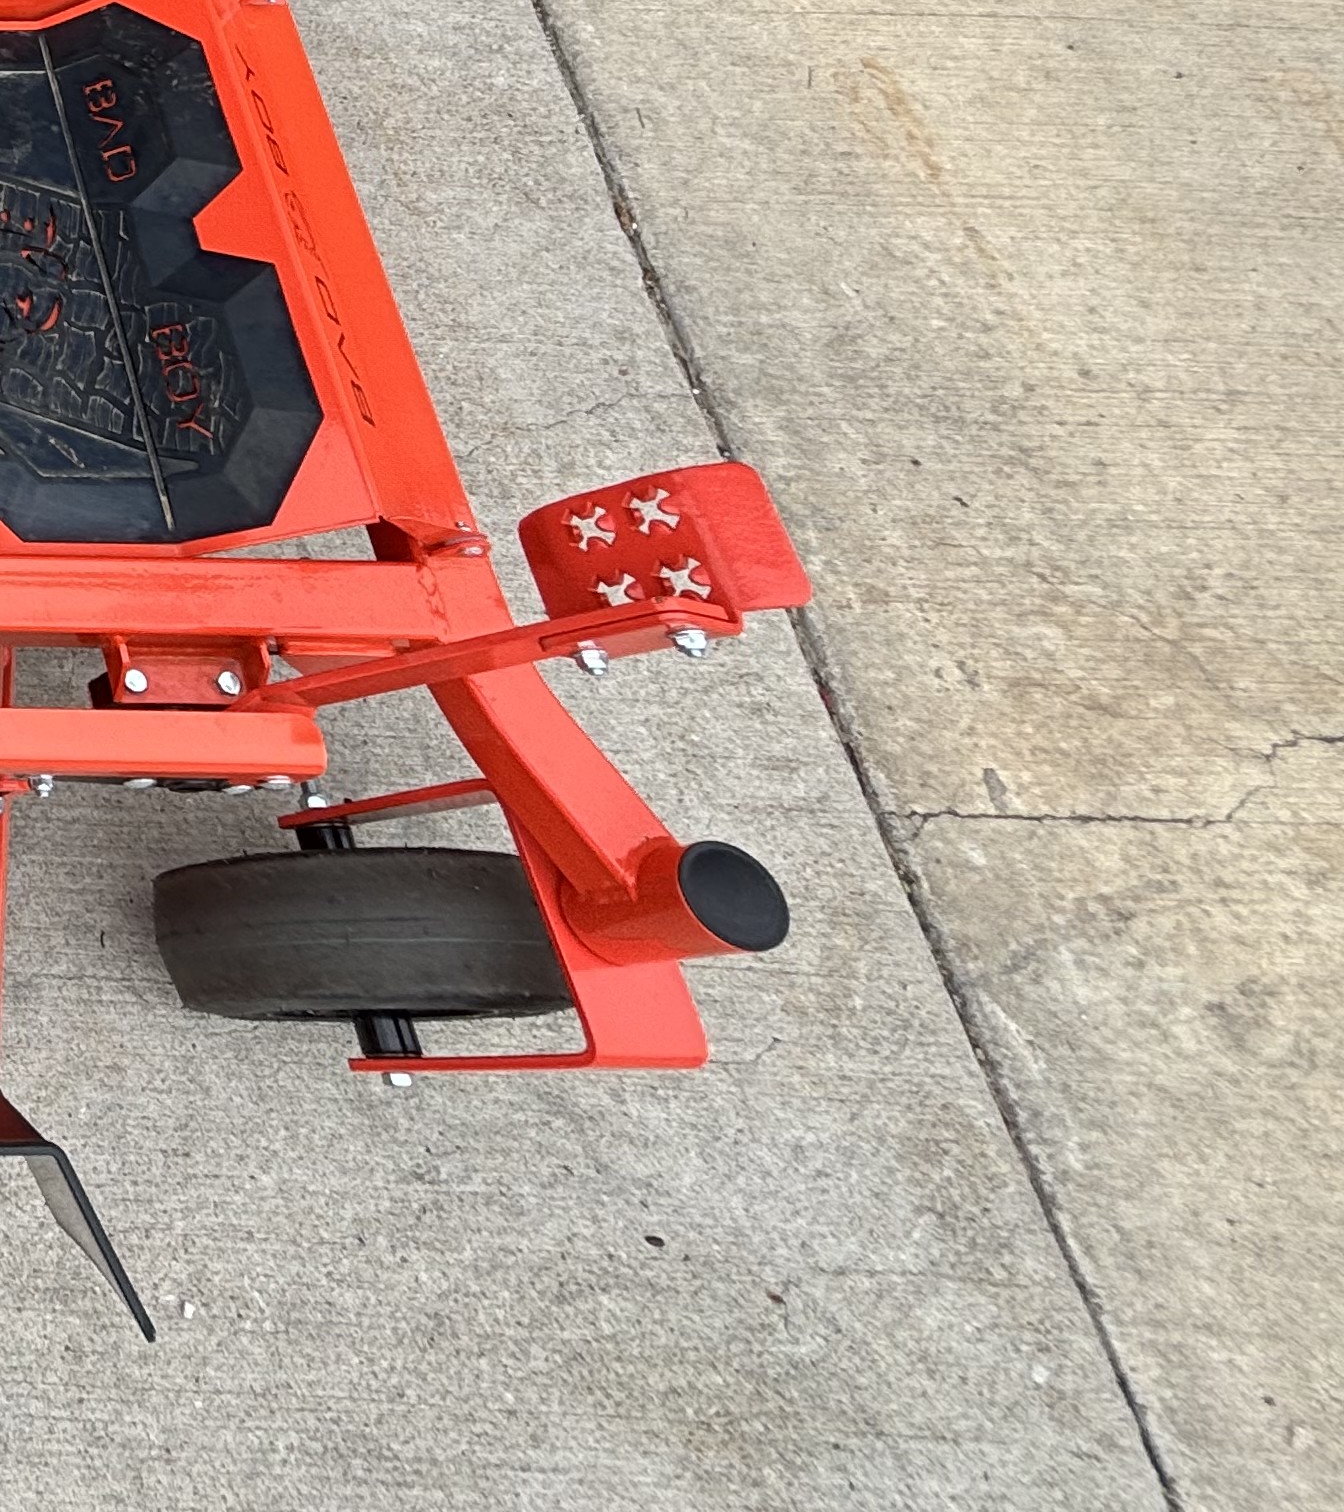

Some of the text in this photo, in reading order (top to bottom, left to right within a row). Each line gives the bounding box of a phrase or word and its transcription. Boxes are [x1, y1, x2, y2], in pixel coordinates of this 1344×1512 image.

[81, 77, 140, 186] BAD
[234, 43, 378, 429] BAD BOY
[147, 321, 218, 440] BOY
